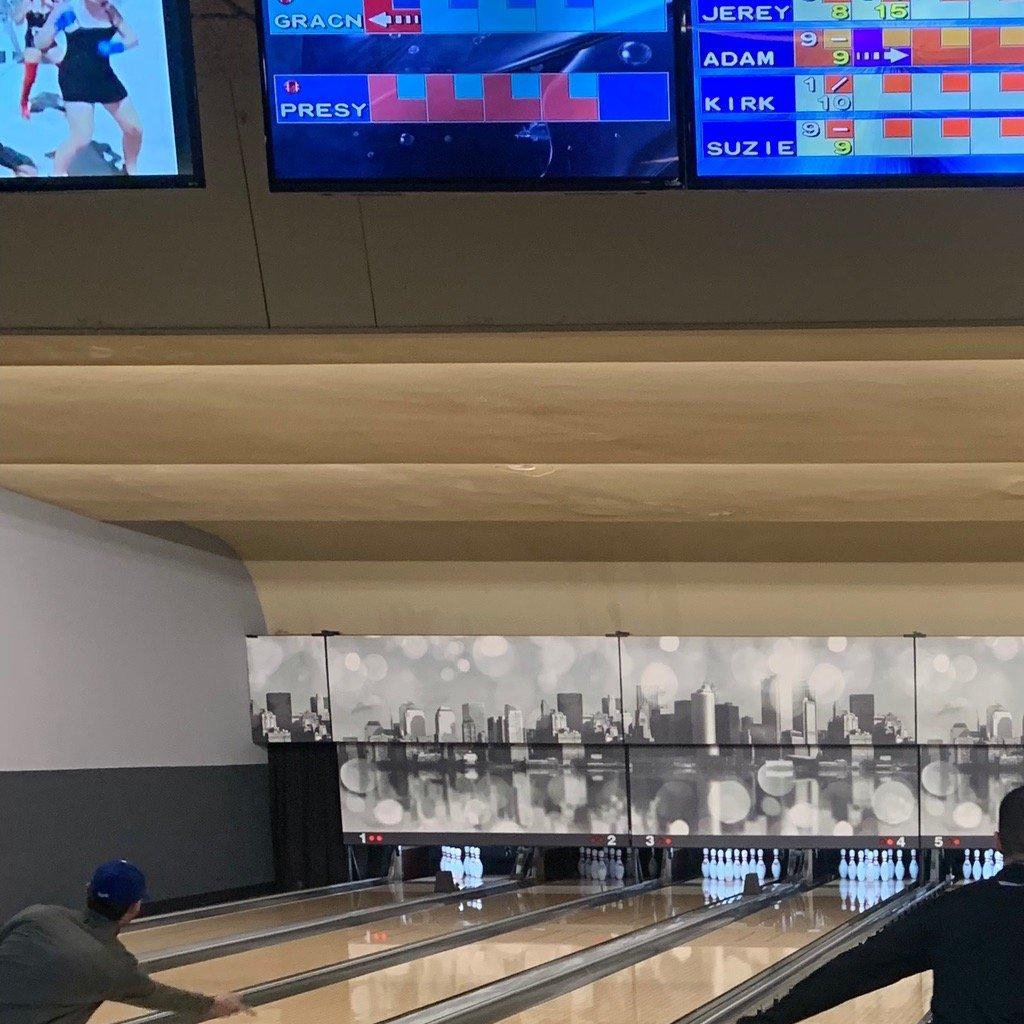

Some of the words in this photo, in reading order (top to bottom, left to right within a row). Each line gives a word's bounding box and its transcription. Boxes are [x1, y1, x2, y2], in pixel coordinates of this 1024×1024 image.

[702, 5, 790, 21] JEREY
[831, 4, 850, 20] 8
[874, 4, 909, 20] 15
[274, 13, 363, 29] GRACN
[800, 31, 818, 47] 9
[703, 50, 775, 67] ADAM
[832, 49, 850, 66] 9
[803, 76, 816, 93] 1
[280, 102, 367, 118] PRESY
[705, 96, 775, 112] KIRK
[817, 95, 851, 111] 10
[801, 121, 821, 138] 9
[707, 140, 795, 156] SUZIE
[833, 139, 852, 156] 9
[359, 832, 366, 844] 1
[607, 834, 617, 846] 2
[645, 835, 655, 846] 3
[896, 836, 906, 847] 4
[934, 836, 944, 847] 5
